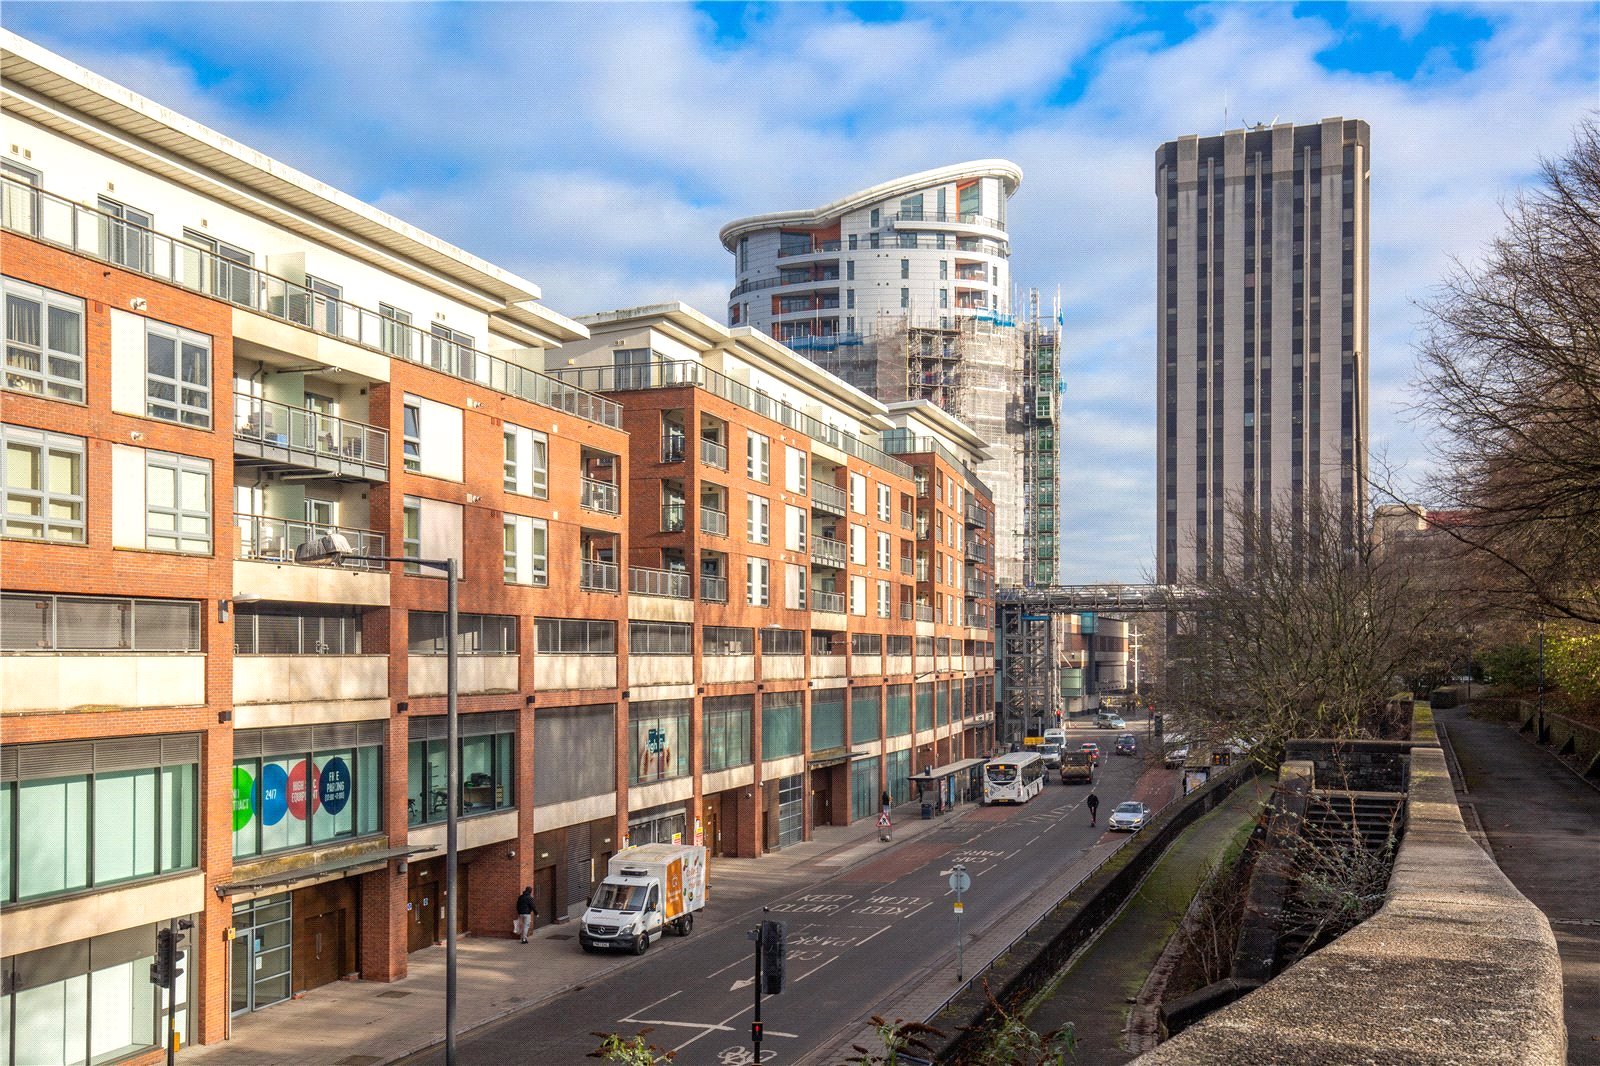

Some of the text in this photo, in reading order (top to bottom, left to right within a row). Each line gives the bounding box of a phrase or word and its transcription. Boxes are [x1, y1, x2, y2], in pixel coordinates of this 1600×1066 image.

[328, 771, 340, 782] FRE
[265, 789, 277, 800] 24/7
[796, 894, 854, 902] KEEP
[769, 904, 840, 913] CLEAR
[851, 906, 909, 915] KEEP
[787, 935, 858, 947] PARK
[786, 950, 823, 961] CA
